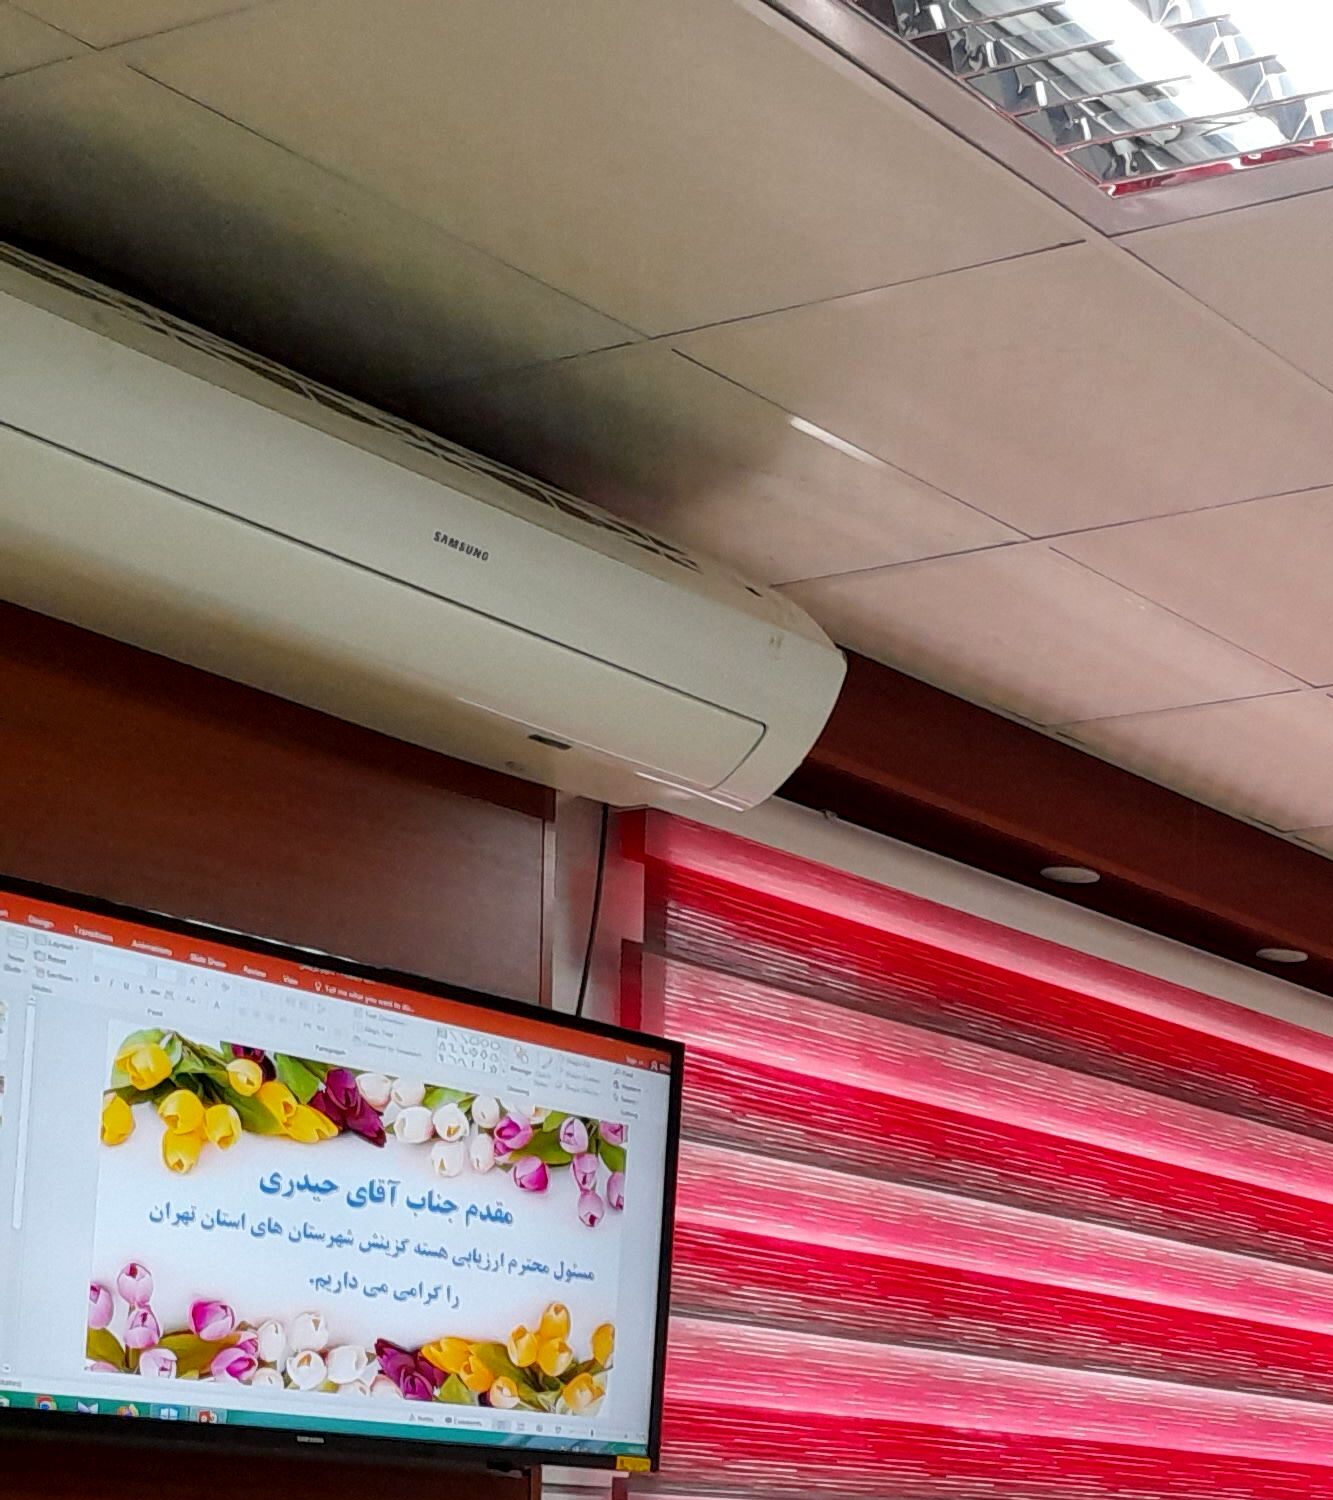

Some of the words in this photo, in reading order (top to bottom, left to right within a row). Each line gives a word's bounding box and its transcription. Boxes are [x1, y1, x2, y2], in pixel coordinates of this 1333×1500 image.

[433, 530, 489, 561] SAMSUNG
[259, 1171, 339, 1202] حیدری
[346, 1179, 402, 1208] آقای
[149, 1201, 197, 1226] تهران
[405, 1189, 458, 1224] جناب
[465, 1200, 514, 1227] مقدم
[200, 1208, 246, 1231] استان
[250, 1216, 283, 1238] های
[288, 1221, 354, 1249] شهرستان
[452, 1248, 505, 1273] ارزیابی
[507, 1257, 550, 1276] محترم
[553, 1260, 595, 1283] مسئول
[363, 1282, 389, 1299] می
[446, 1285, 460, 1309] را
